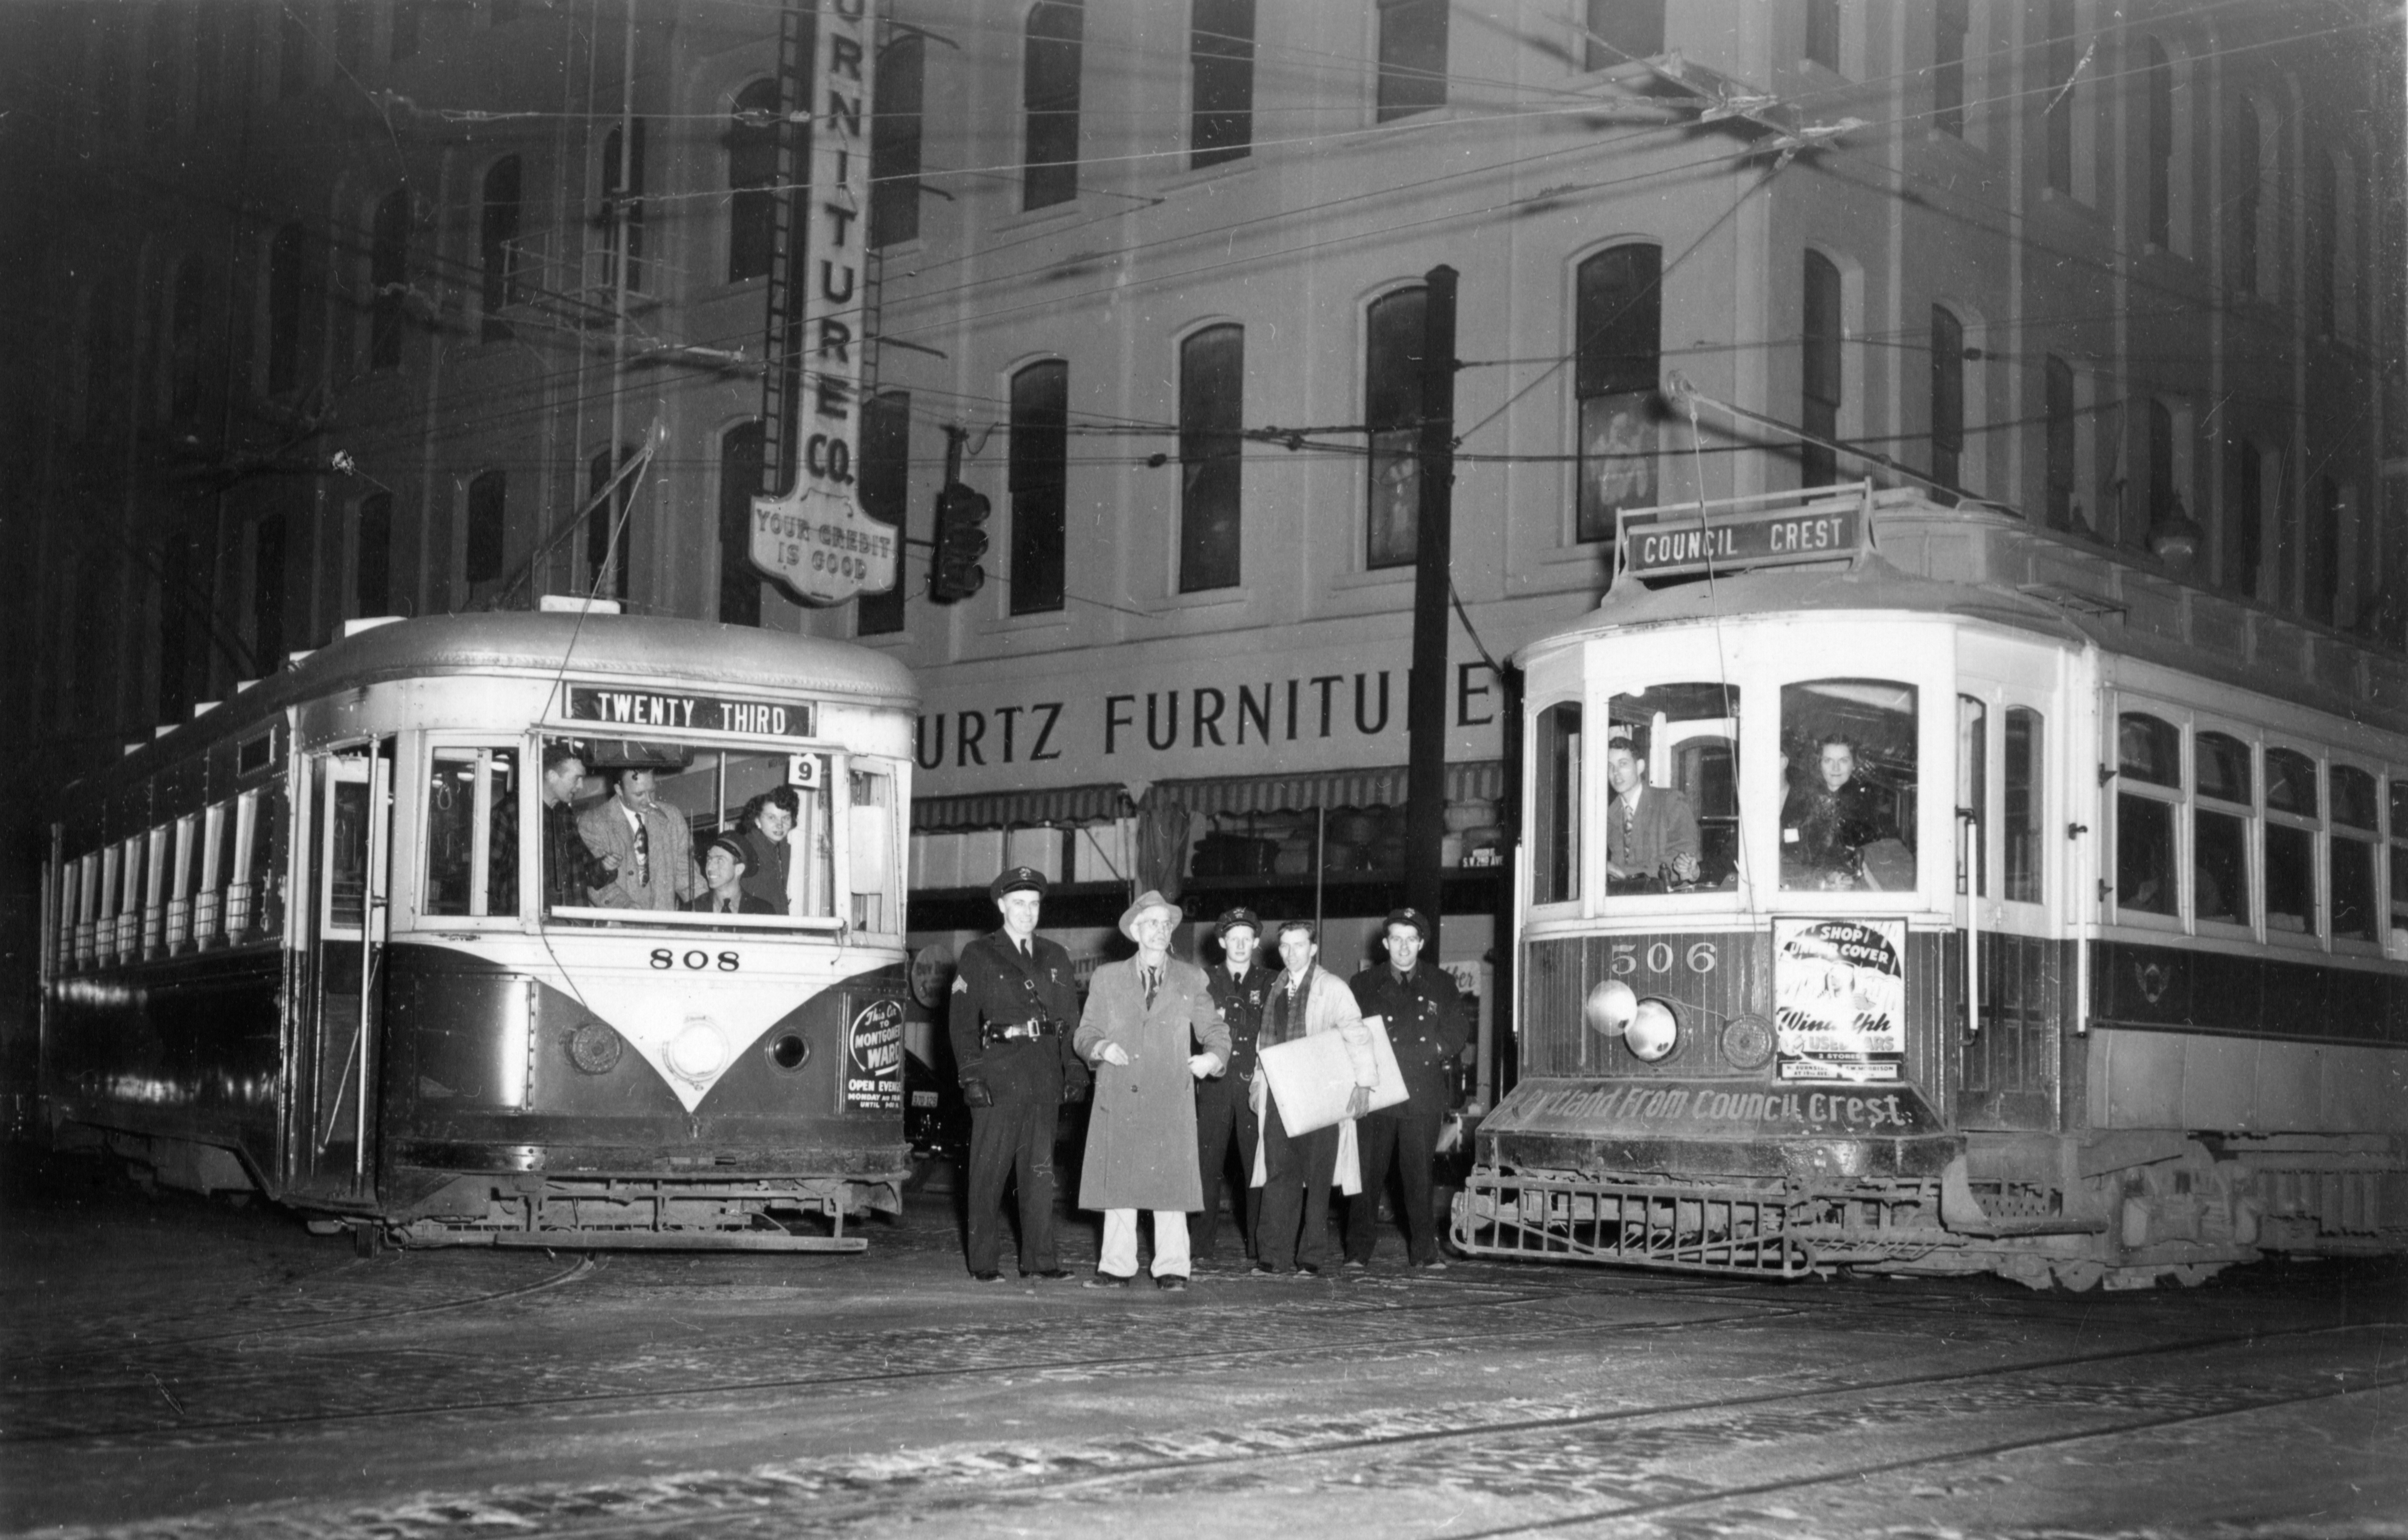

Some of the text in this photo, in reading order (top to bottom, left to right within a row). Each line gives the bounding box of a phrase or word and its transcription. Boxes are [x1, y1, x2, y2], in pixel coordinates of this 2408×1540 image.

[806, 433, 854, 486] CO.
[756, 508, 891, 559] YOUR CREDIT
[1644, 518, 1843, 564] COUNCIL CREST
[777, 541, 867, 580] IS GOOD
[597, 692, 786, 735] TWENTY THIRD
[1105, 661, 1494, 755] FURNITUE
[798, 761, 812, 781] 9
[1819, 926, 1863, 942] SHOP
[650, 948, 739, 972] 808
[1611, 941, 1716, 975] 506
[1841, 943, 1889, 964] COVER
[864, 1008, 885, 1026] This
[879, 1020, 889, 1028] TO
[1861, 1036, 1894, 1051] ARS
[848, 1078, 875, 1091] OPEN
[847, 1093, 881, 1101] MONDAY
[1614, 1087, 1690, 1118] From
[1692, 1089, 1798, 1123] Council
[1809, 1093, 1906, 1126] Crest
